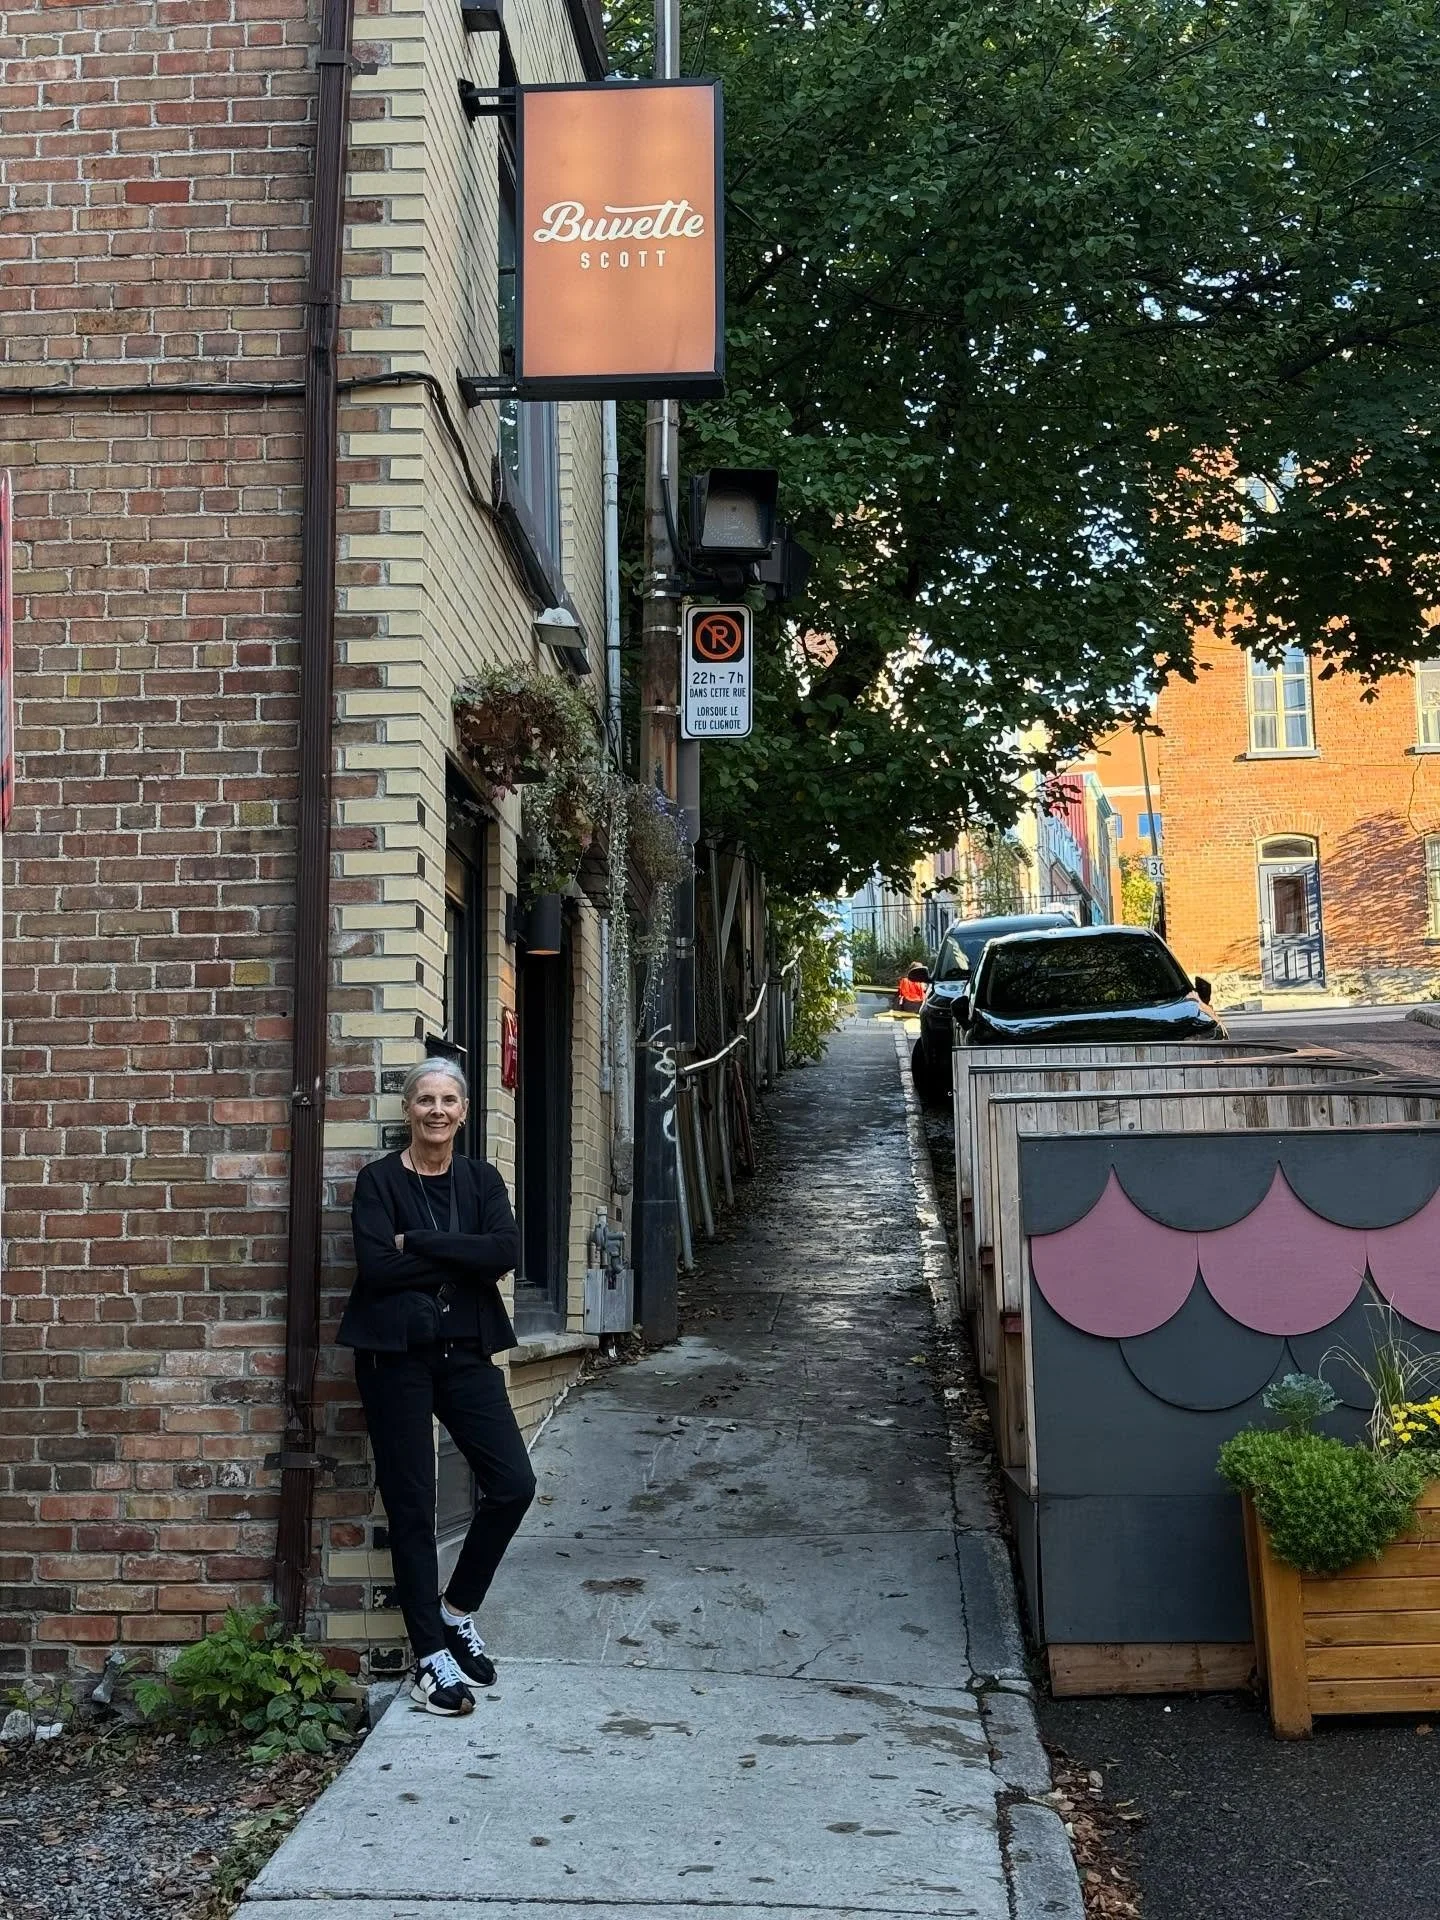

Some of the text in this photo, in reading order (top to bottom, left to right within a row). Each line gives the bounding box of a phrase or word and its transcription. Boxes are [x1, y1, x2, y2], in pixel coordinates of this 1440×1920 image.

[533, 199, 704, 243] Buvette
[580, 250, 666, 269] SCOTT
[692, 671, 716, 685] 22h
[728, 671, 744, 684] 7h
[689, 687, 746, 698] DANS CETTE RUE
[697, 706, 739, 717] LORSQUE LE
[694, 719, 741, 730] FEU CLIGNOTE
